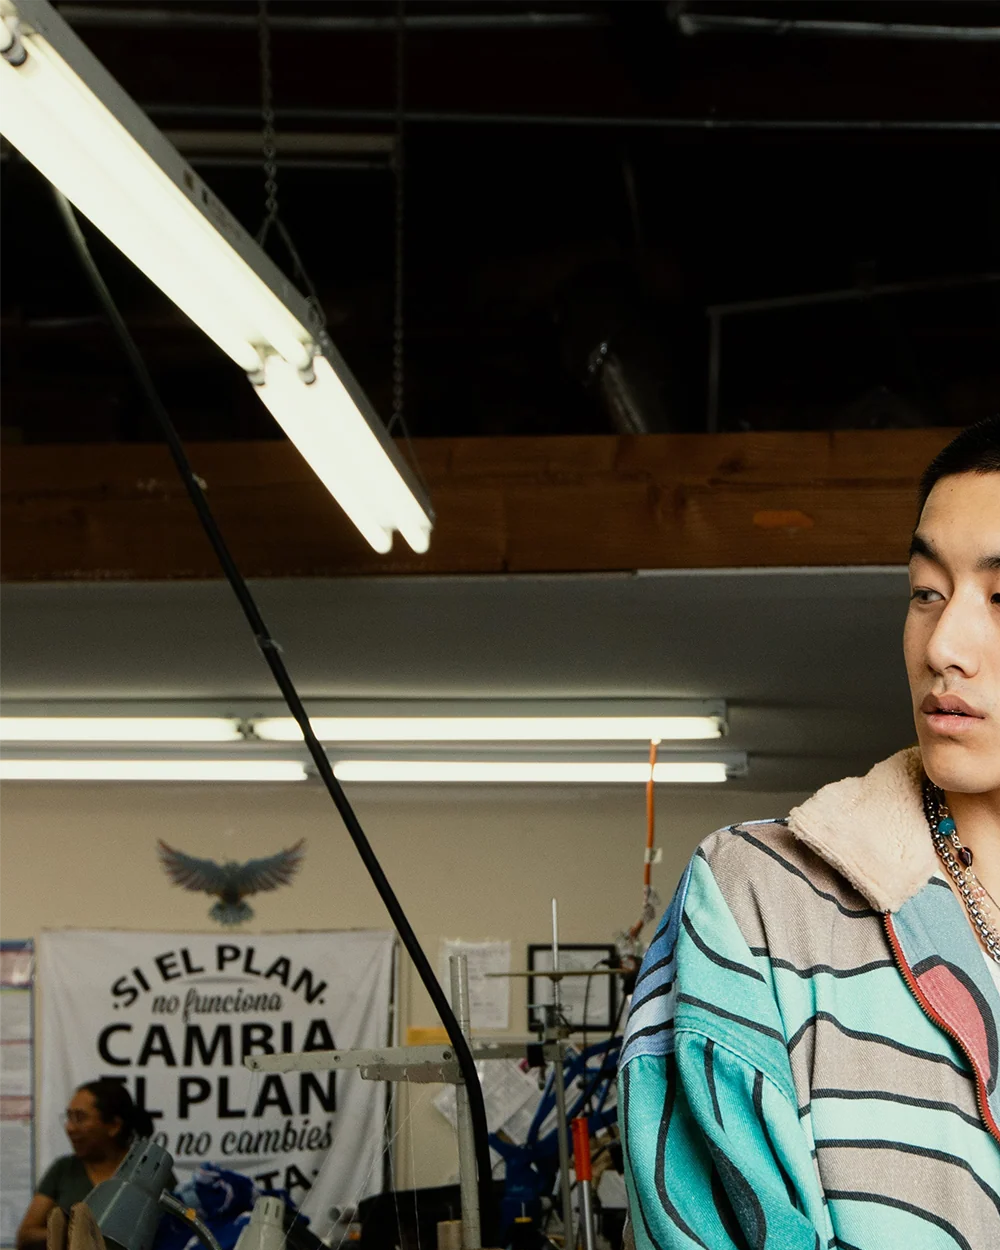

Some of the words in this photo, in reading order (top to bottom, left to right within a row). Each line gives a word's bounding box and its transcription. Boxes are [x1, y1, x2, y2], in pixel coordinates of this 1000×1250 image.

[154, 947, 205, 982] EL
[152, 994, 180, 1014] no
[181, 987, 284, 1024] funciona
[97, 1018, 337, 1067] CAMBIA
[178, 1070, 338, 1120] PLAN
[175, 1130, 212, 1156] no
[220, 1119, 333, 1156] cambies
